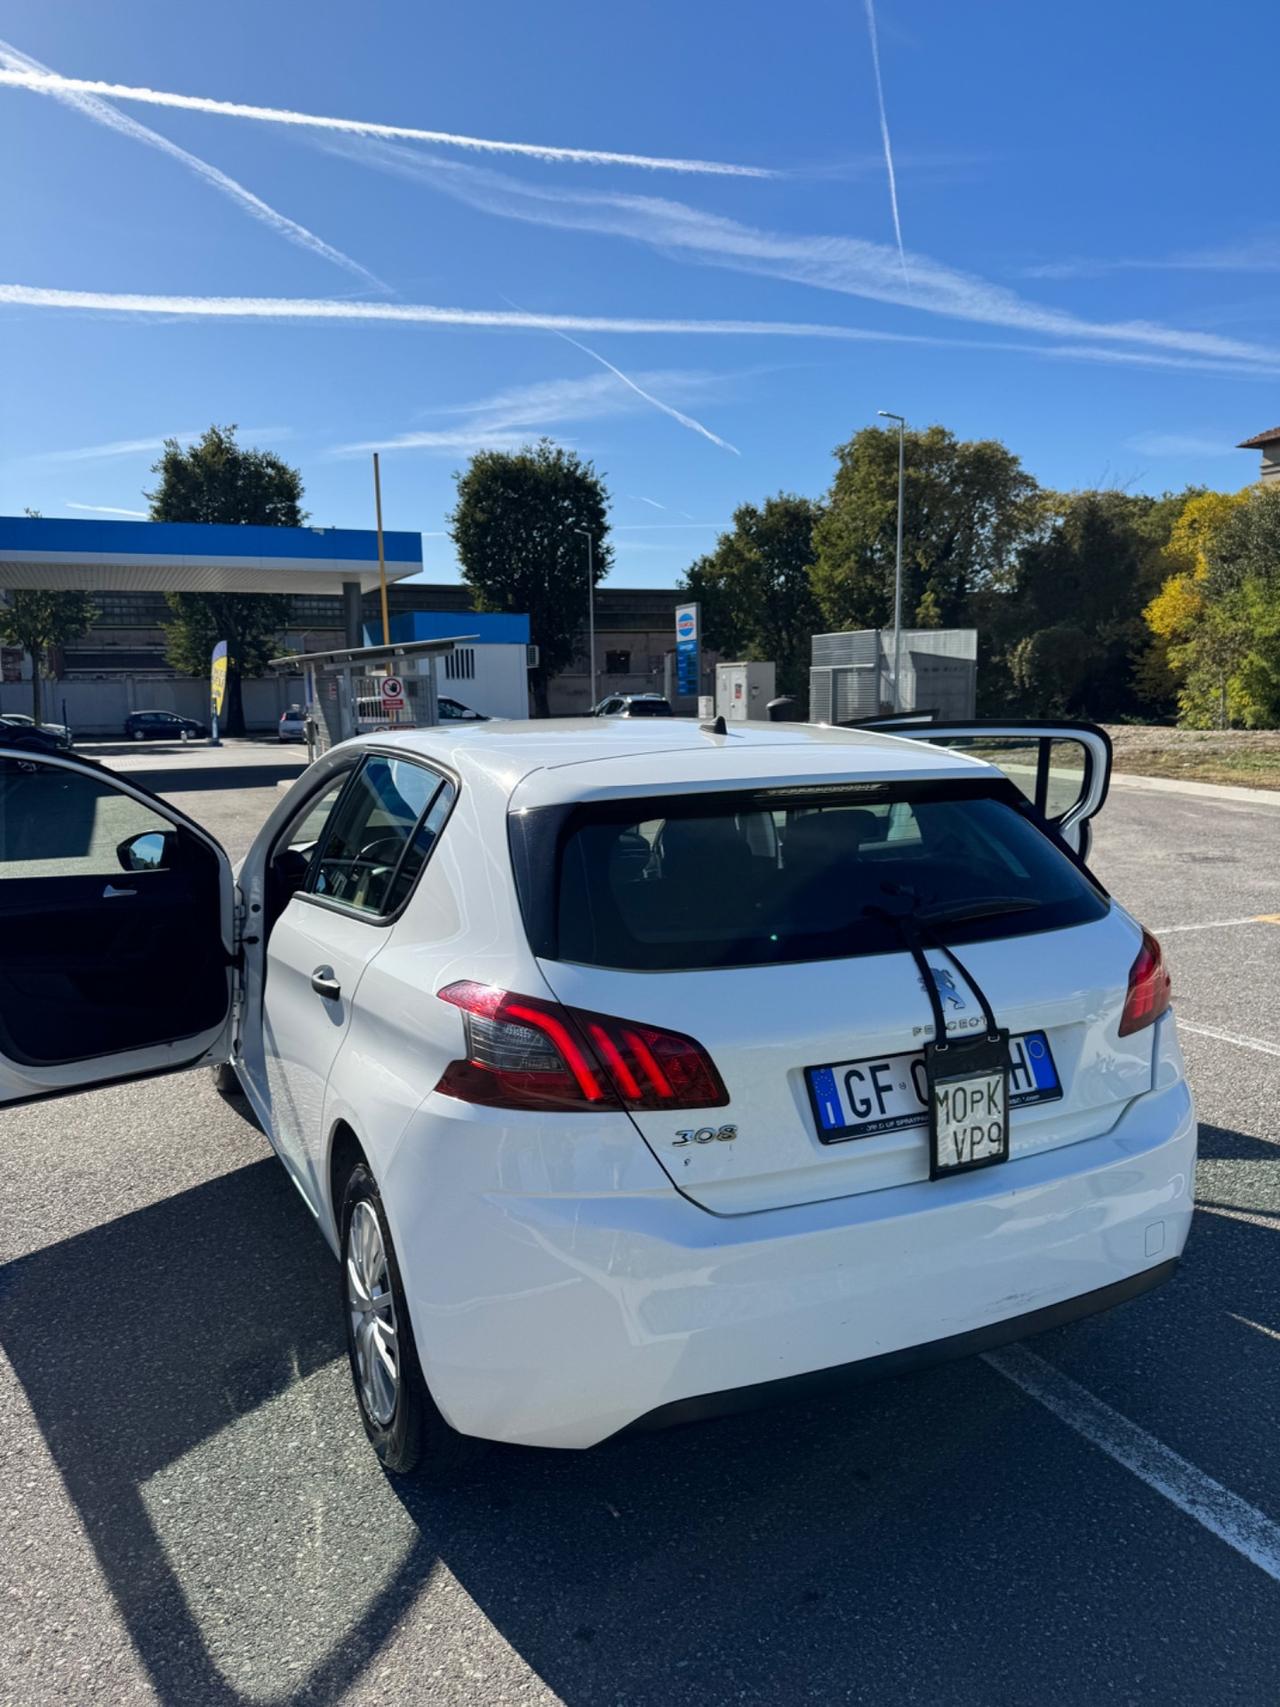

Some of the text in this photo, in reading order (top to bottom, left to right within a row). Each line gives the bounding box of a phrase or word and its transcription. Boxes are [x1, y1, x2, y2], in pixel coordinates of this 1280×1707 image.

[912, 1016, 987, 1036] PEGEOT
[844, 1063, 893, 1119] GF
[671, 1124, 738, 1147] 308
[953, 1121, 1002, 1164] VP9
